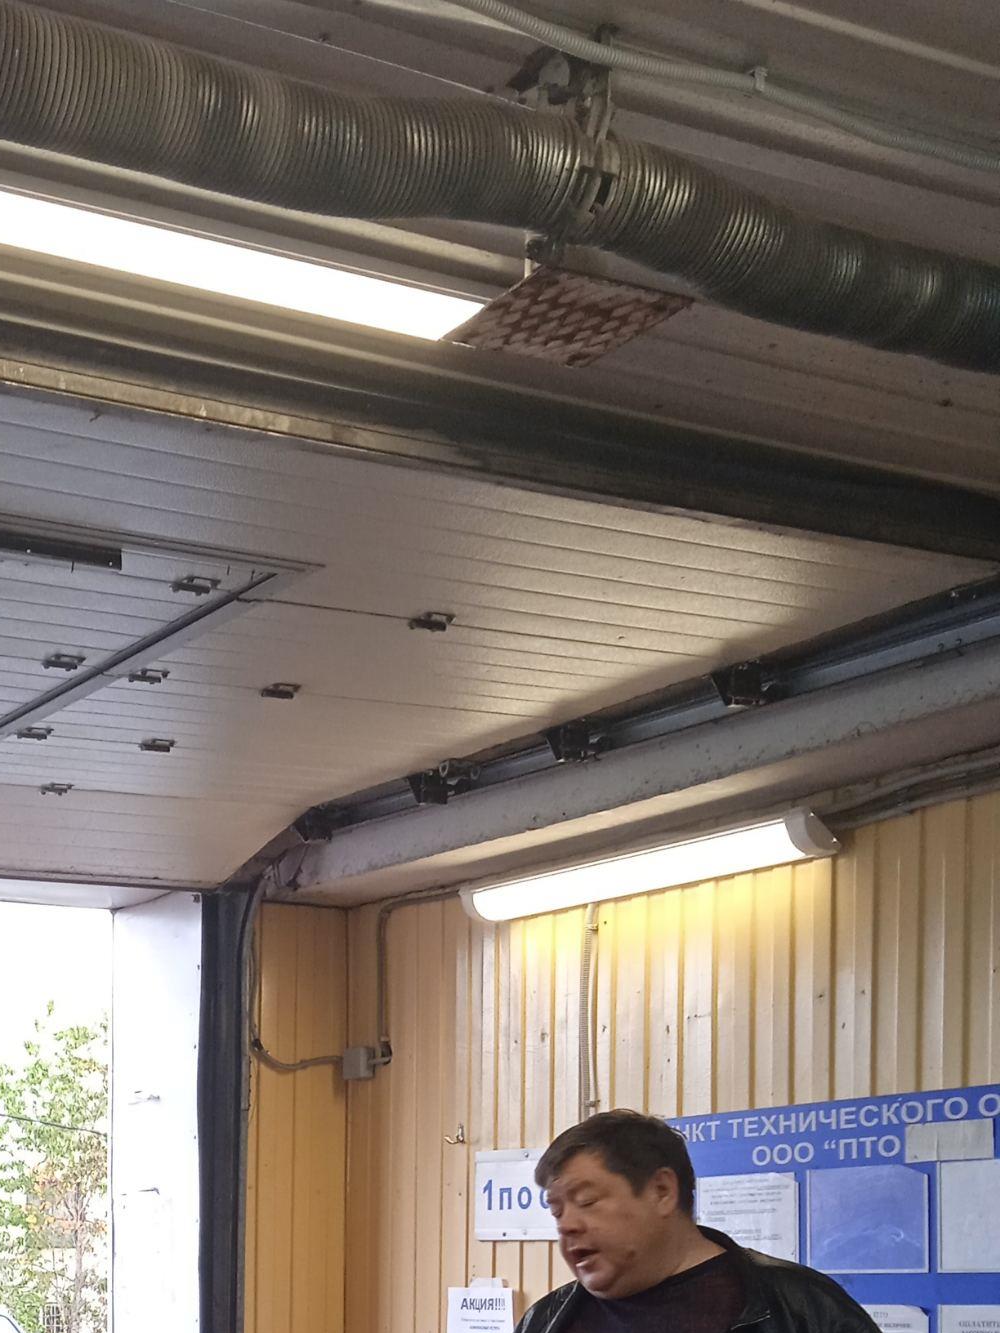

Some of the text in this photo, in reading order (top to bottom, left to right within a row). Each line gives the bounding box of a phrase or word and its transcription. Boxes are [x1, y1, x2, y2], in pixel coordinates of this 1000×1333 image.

[674, 1120, 721, 1143] НКТ
[728, 1096, 969, 1139] ТЕХНИЧЕСКОГО
[751, 1142, 815, 1167] ООО
[482, 1179, 550, 1211] 1пос
